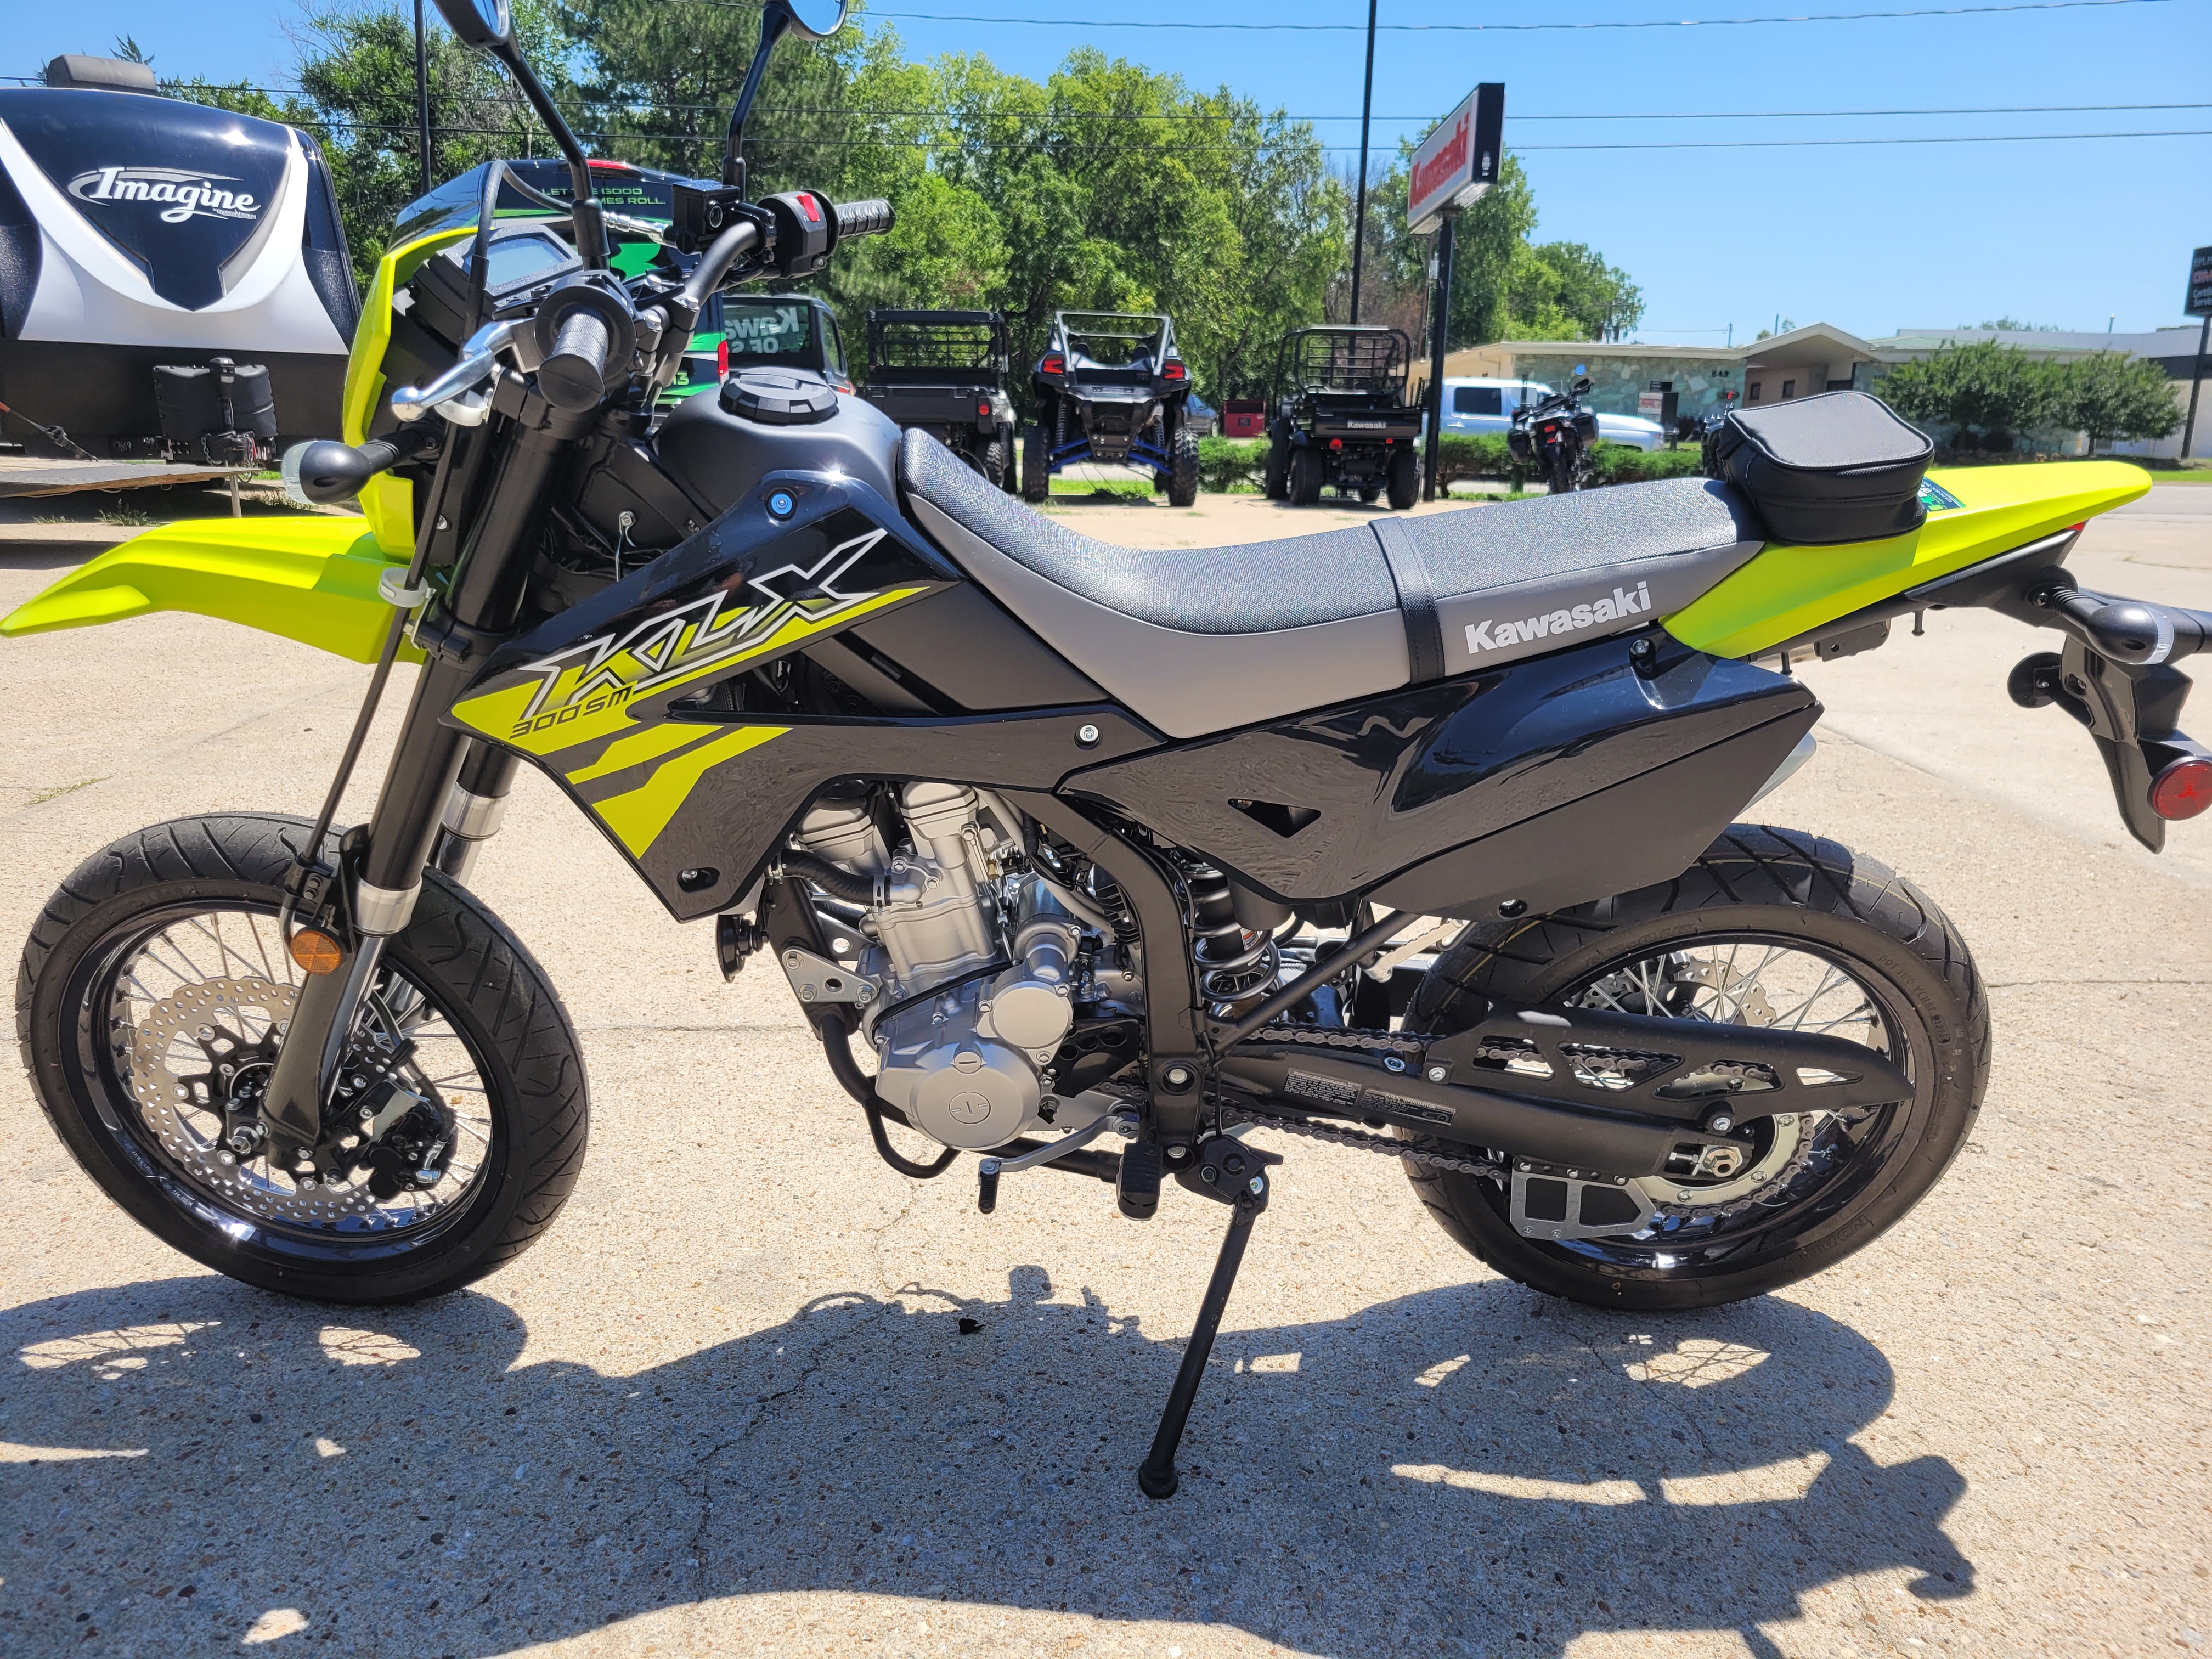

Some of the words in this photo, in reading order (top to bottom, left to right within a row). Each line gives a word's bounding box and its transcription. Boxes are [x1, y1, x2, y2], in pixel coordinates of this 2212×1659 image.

[89, 167, 261, 223] Imagine
[601, 187, 642, 195] GOOD
[1347, 420, 1386, 429] Kawasaki
[518, 528, 888, 720] KLX
[1464, 580, 1651, 654] Kawasaki
[1385, 1093, 1401, 1102] CHAIN
[1402, 1098, 1436, 1110] INFORMATION
